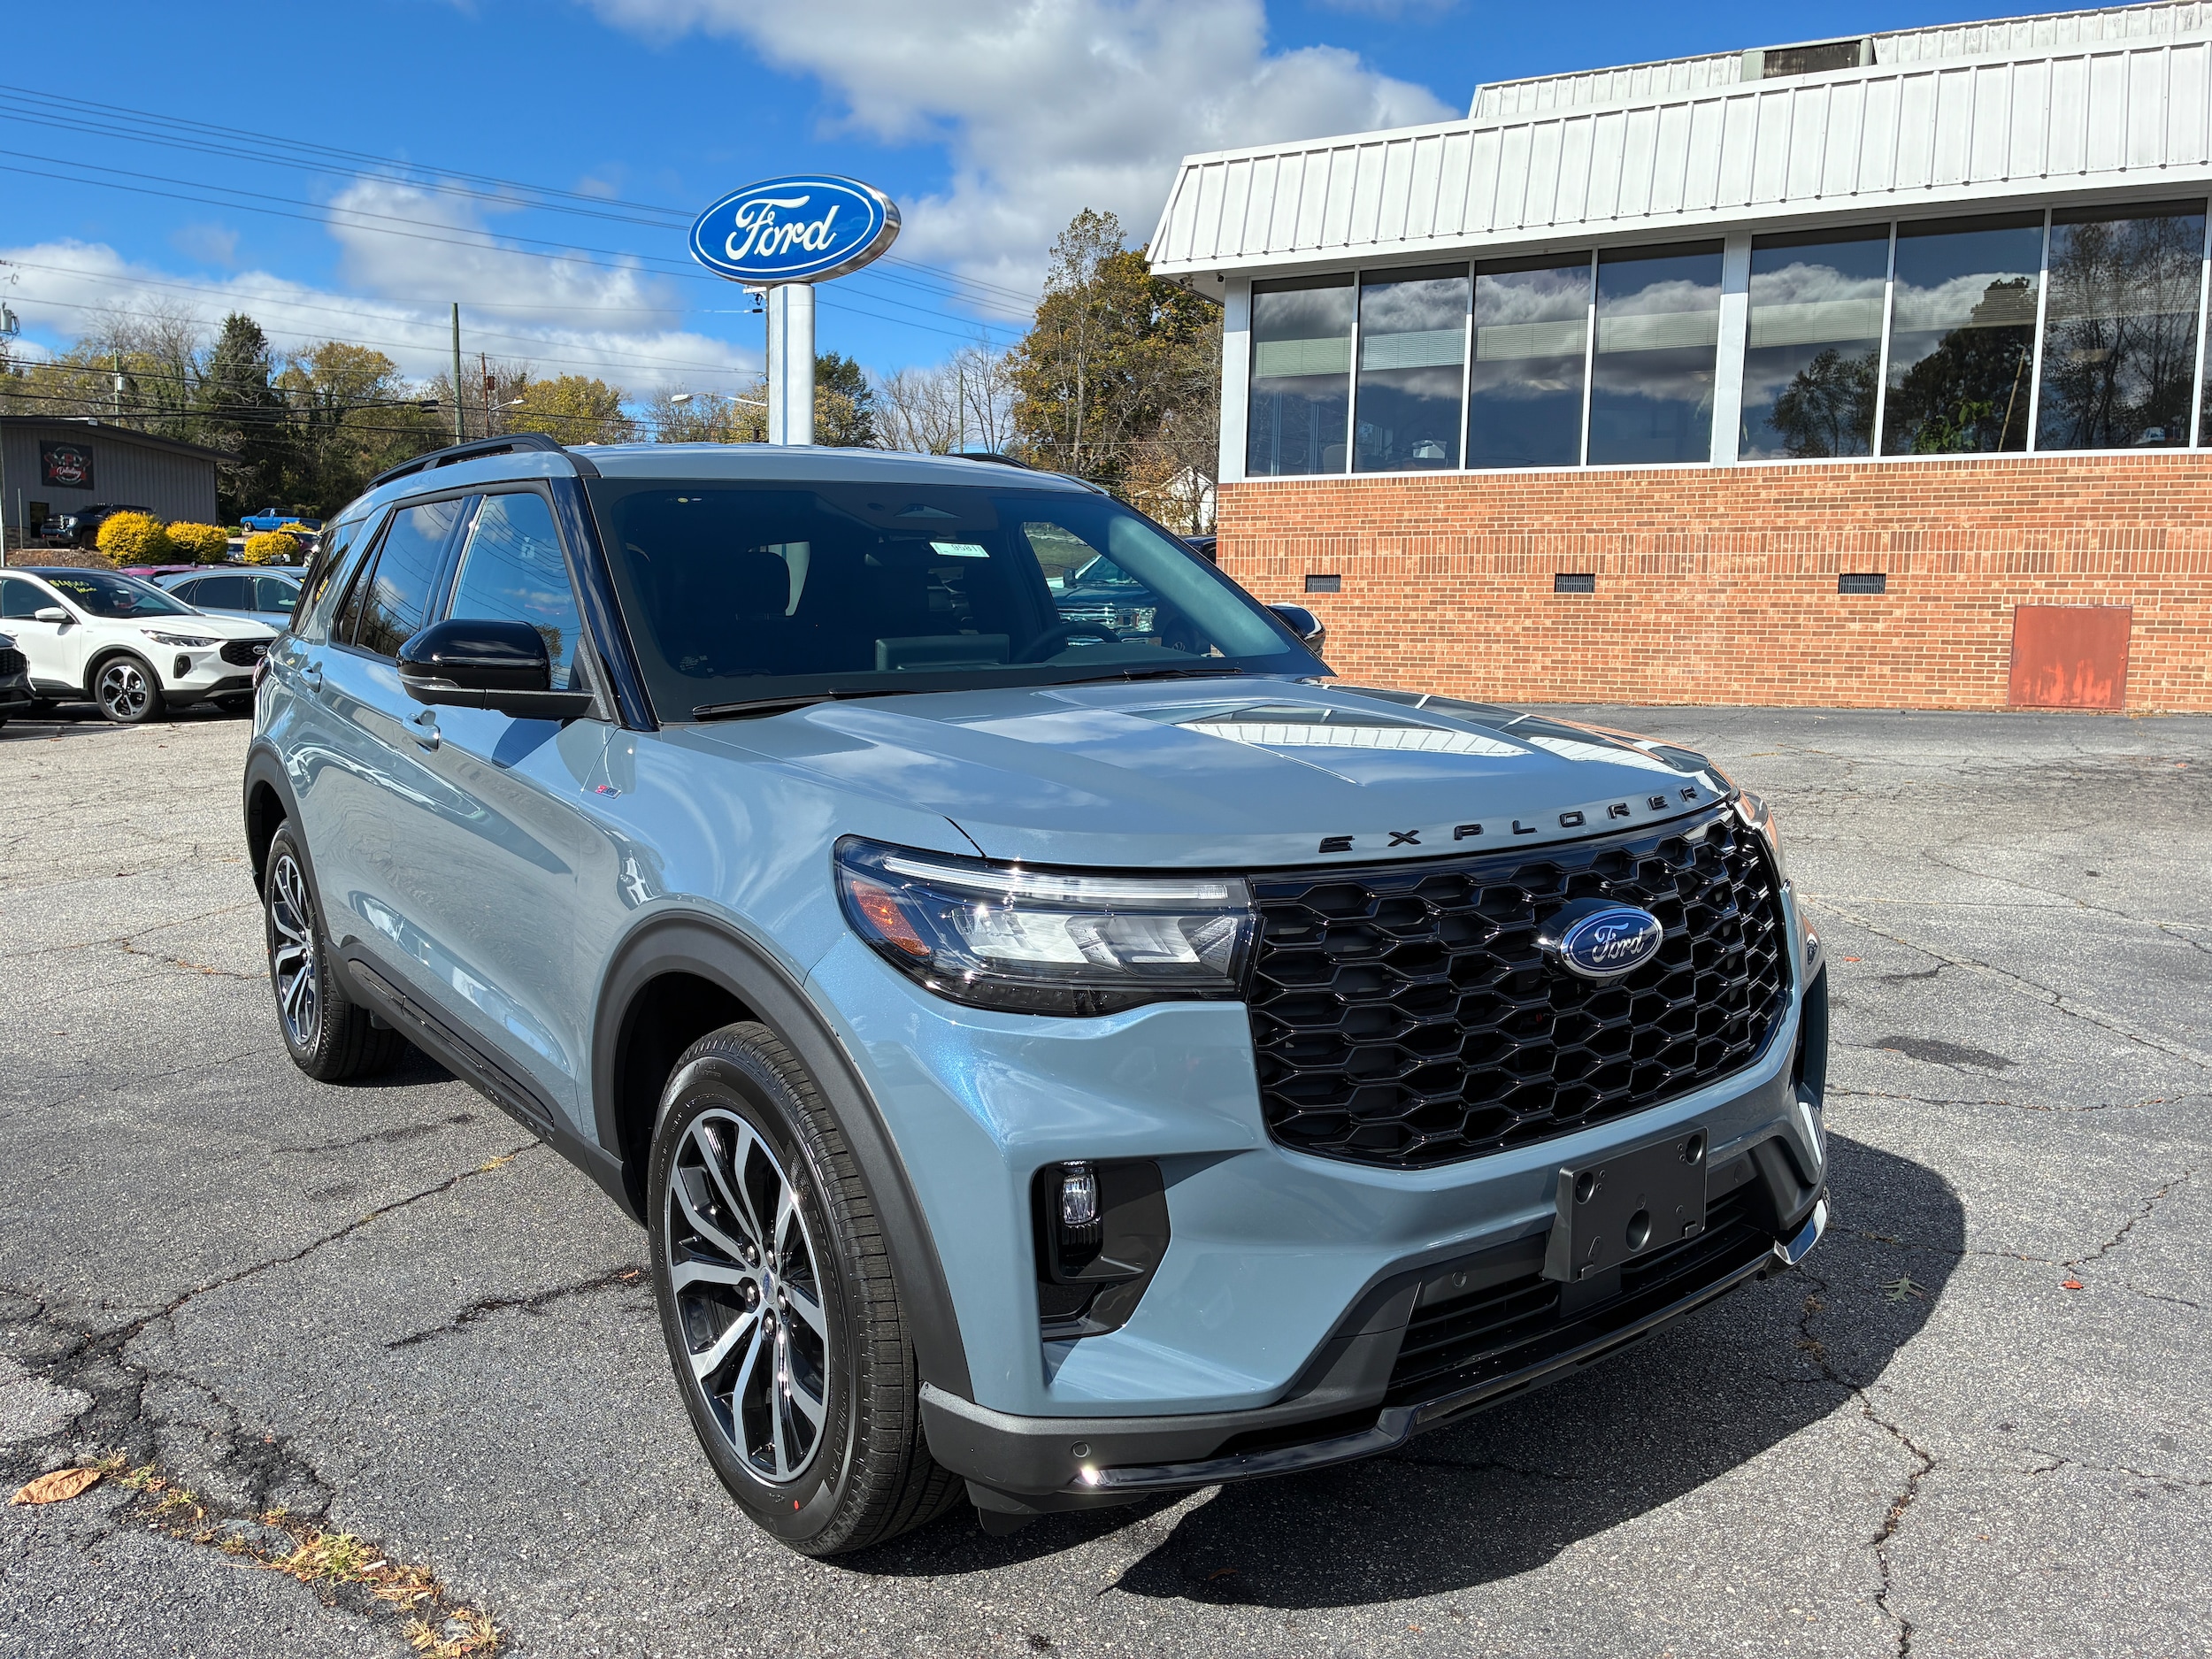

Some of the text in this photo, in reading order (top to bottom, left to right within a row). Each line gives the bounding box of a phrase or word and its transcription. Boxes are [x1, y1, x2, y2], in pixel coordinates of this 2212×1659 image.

[725, 195, 841, 260] Ford
[1318, 787, 1699, 853] EXPLORER
[1593, 922, 1645, 963] Ford
